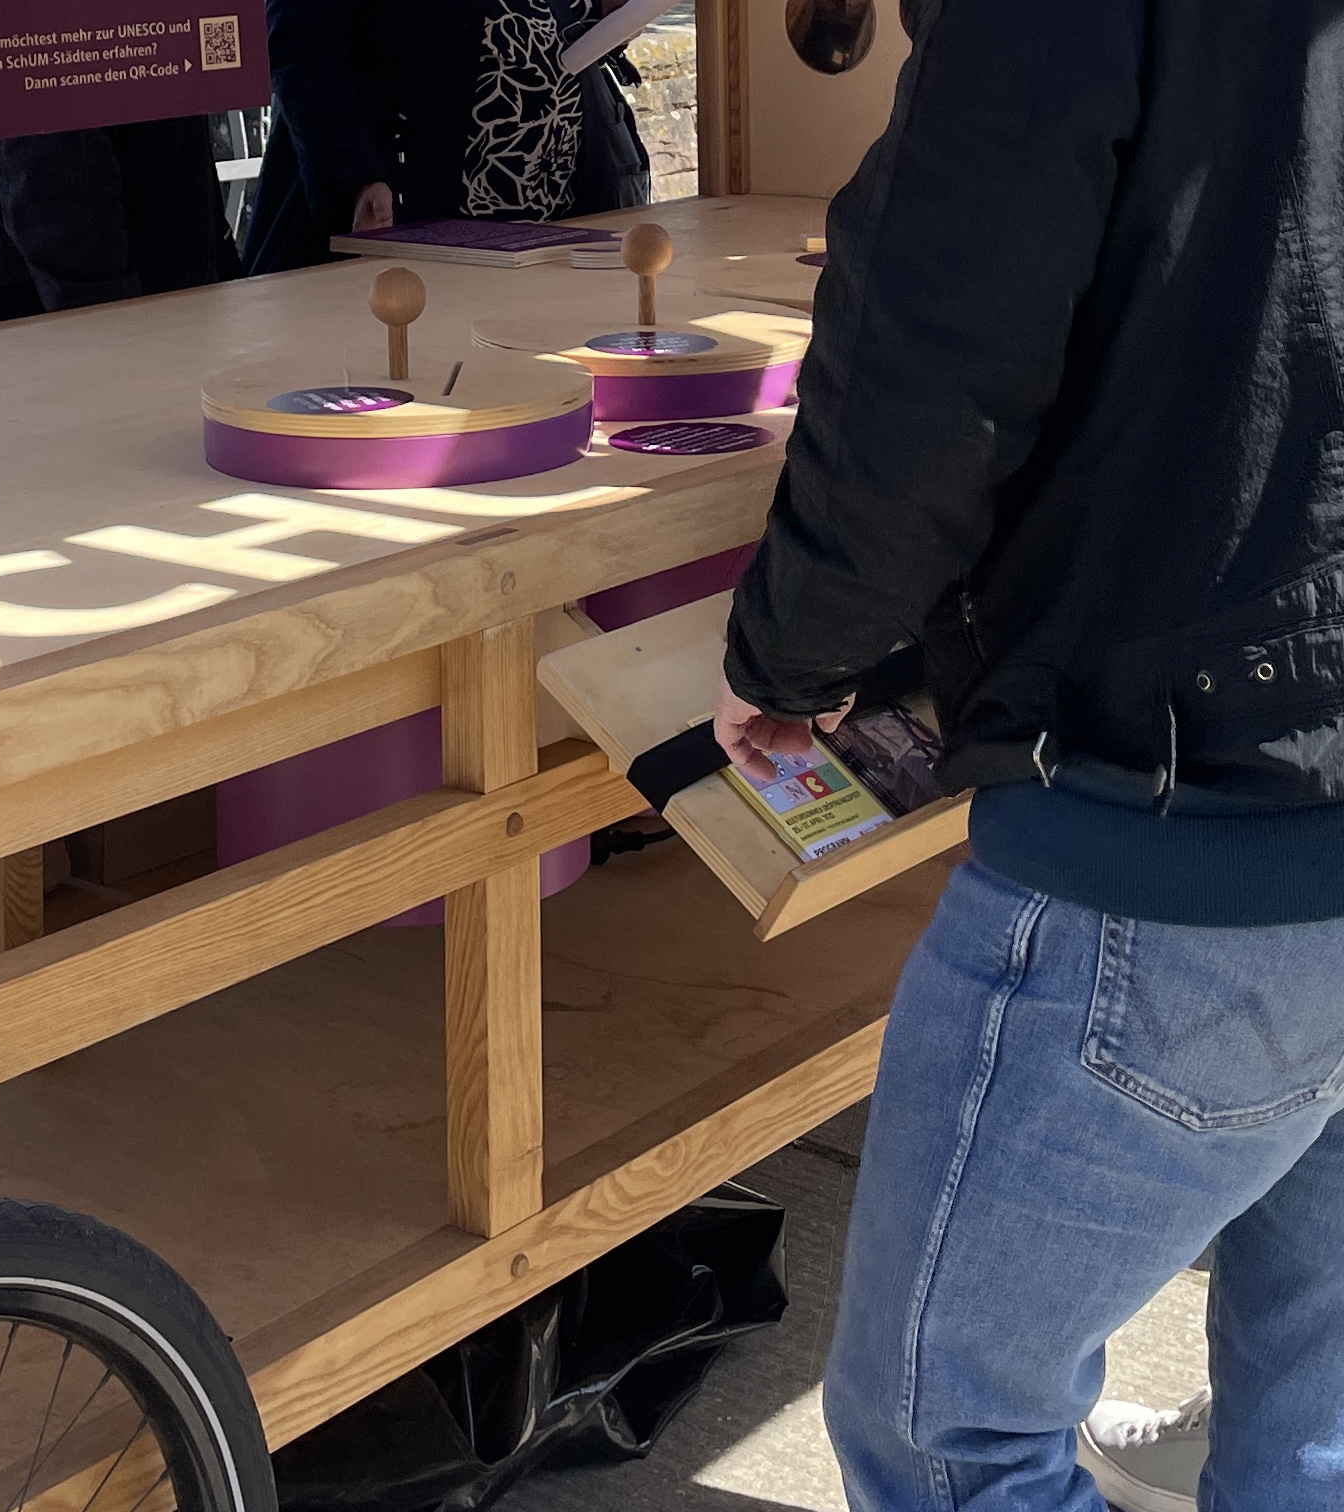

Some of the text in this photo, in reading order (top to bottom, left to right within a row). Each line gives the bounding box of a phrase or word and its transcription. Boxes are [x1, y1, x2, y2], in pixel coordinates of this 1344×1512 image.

[0, 31, 58, 49] möchtest
[60, 27, 93, 43] mehr
[95, 28, 115, 41] zur
[117, 21, 166, 39] UNESCO
[168, 18, 191, 34] und
[5, 48, 100, 70] SchUM-Städten
[102, 41, 158, 60] erfahren?
